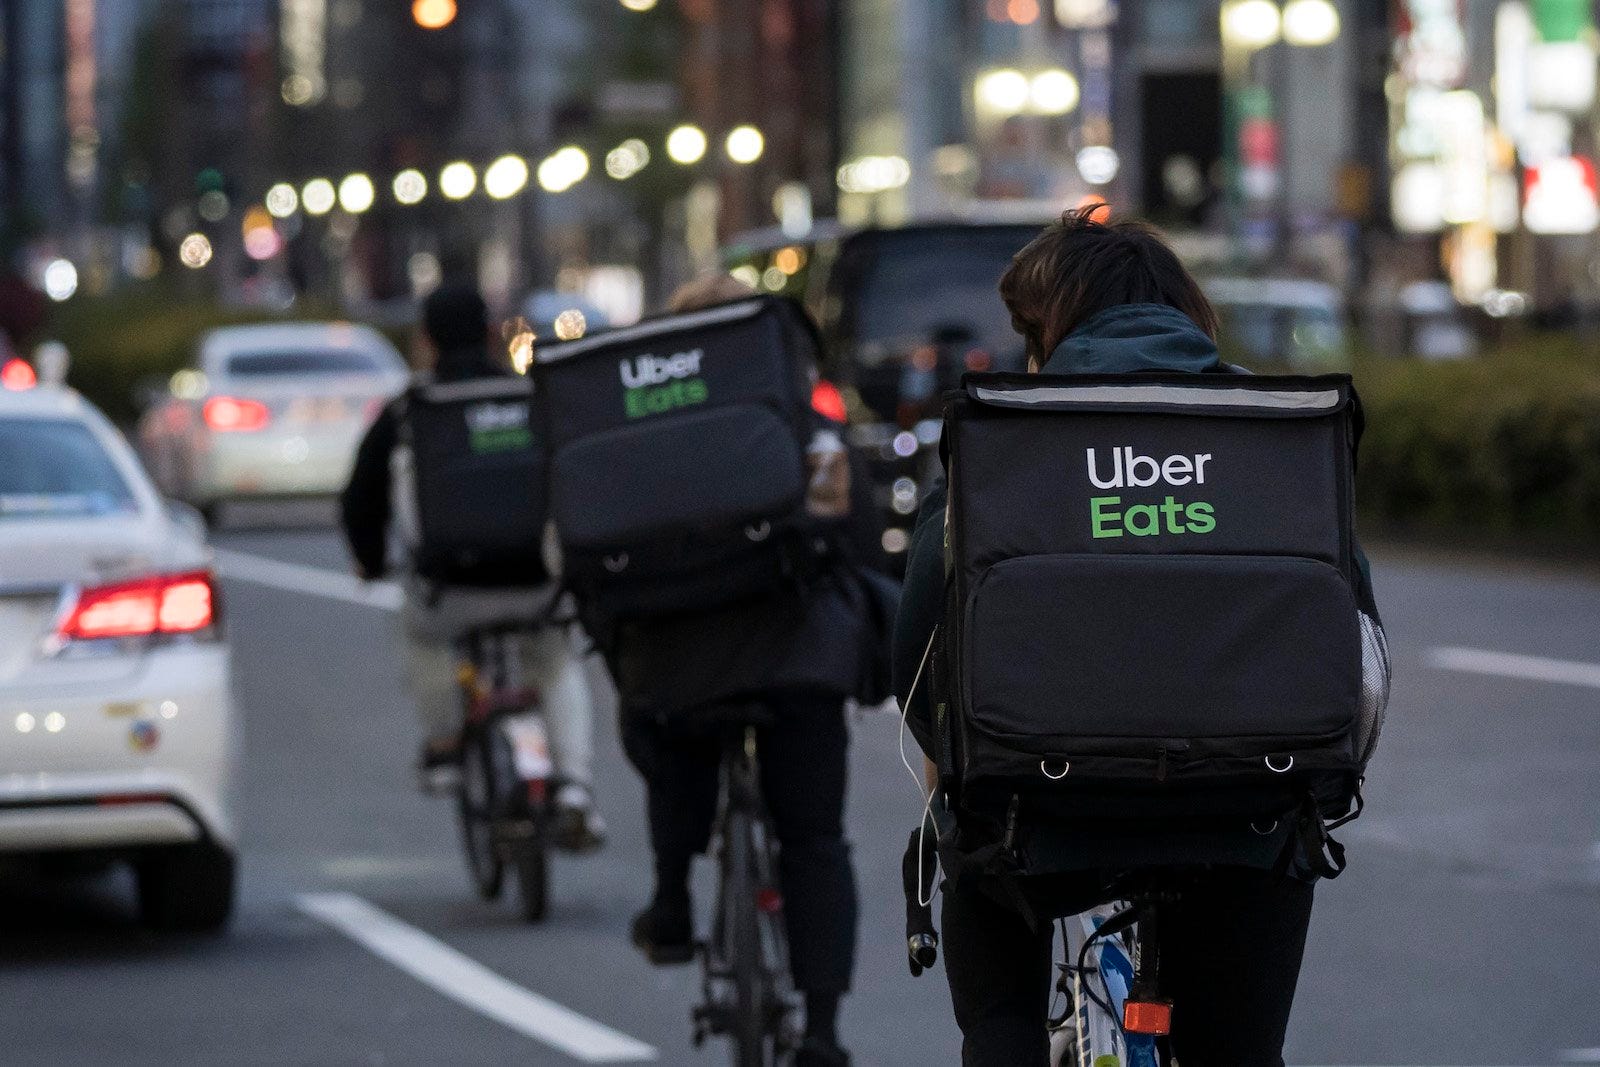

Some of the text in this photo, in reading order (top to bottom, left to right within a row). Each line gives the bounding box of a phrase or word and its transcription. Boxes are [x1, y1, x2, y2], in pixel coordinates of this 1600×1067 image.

[620, 348, 703, 389] Uber
[1086, 446, 1212, 488] Uber
[1090, 496, 1216, 538] Eats
